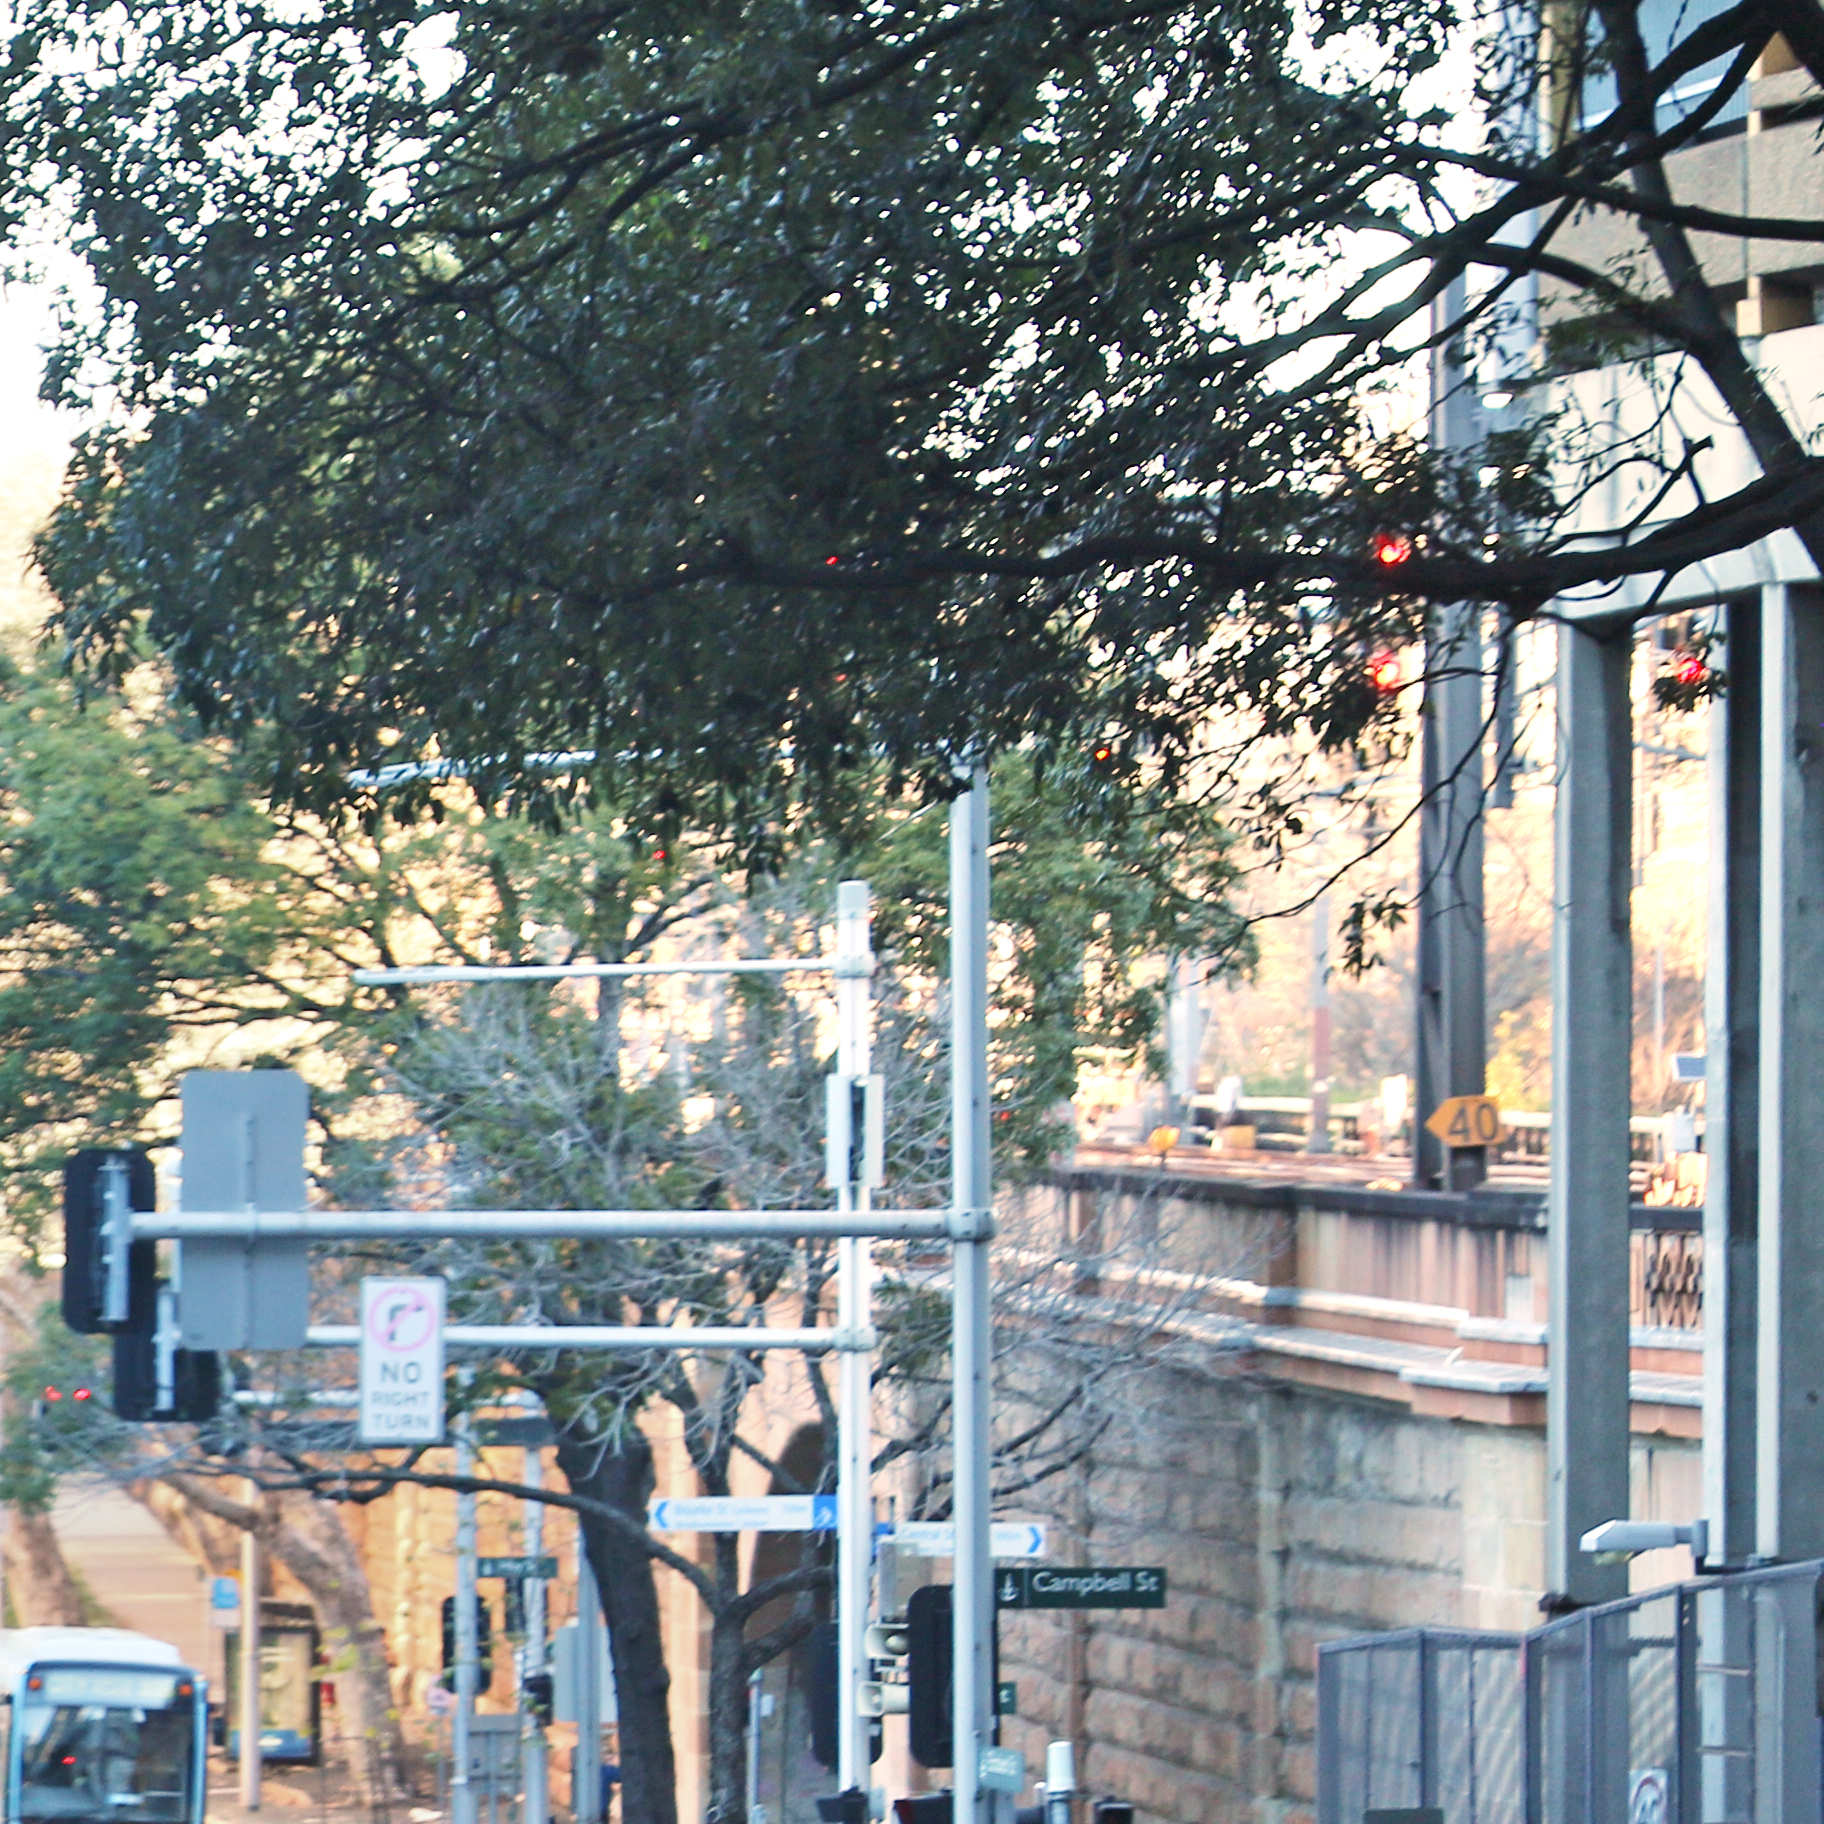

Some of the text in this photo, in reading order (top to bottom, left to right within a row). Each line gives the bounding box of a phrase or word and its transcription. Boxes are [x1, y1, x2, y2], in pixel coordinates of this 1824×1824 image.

[1448, 1102, 1498, 1141] 40
[380, 1362, 421, 1384] NO
[372, 1390, 429, 1408] RIGHT
[373, 1412, 429, 1430] TURN
[1031, 1571, 1160, 1598] Campbell St
